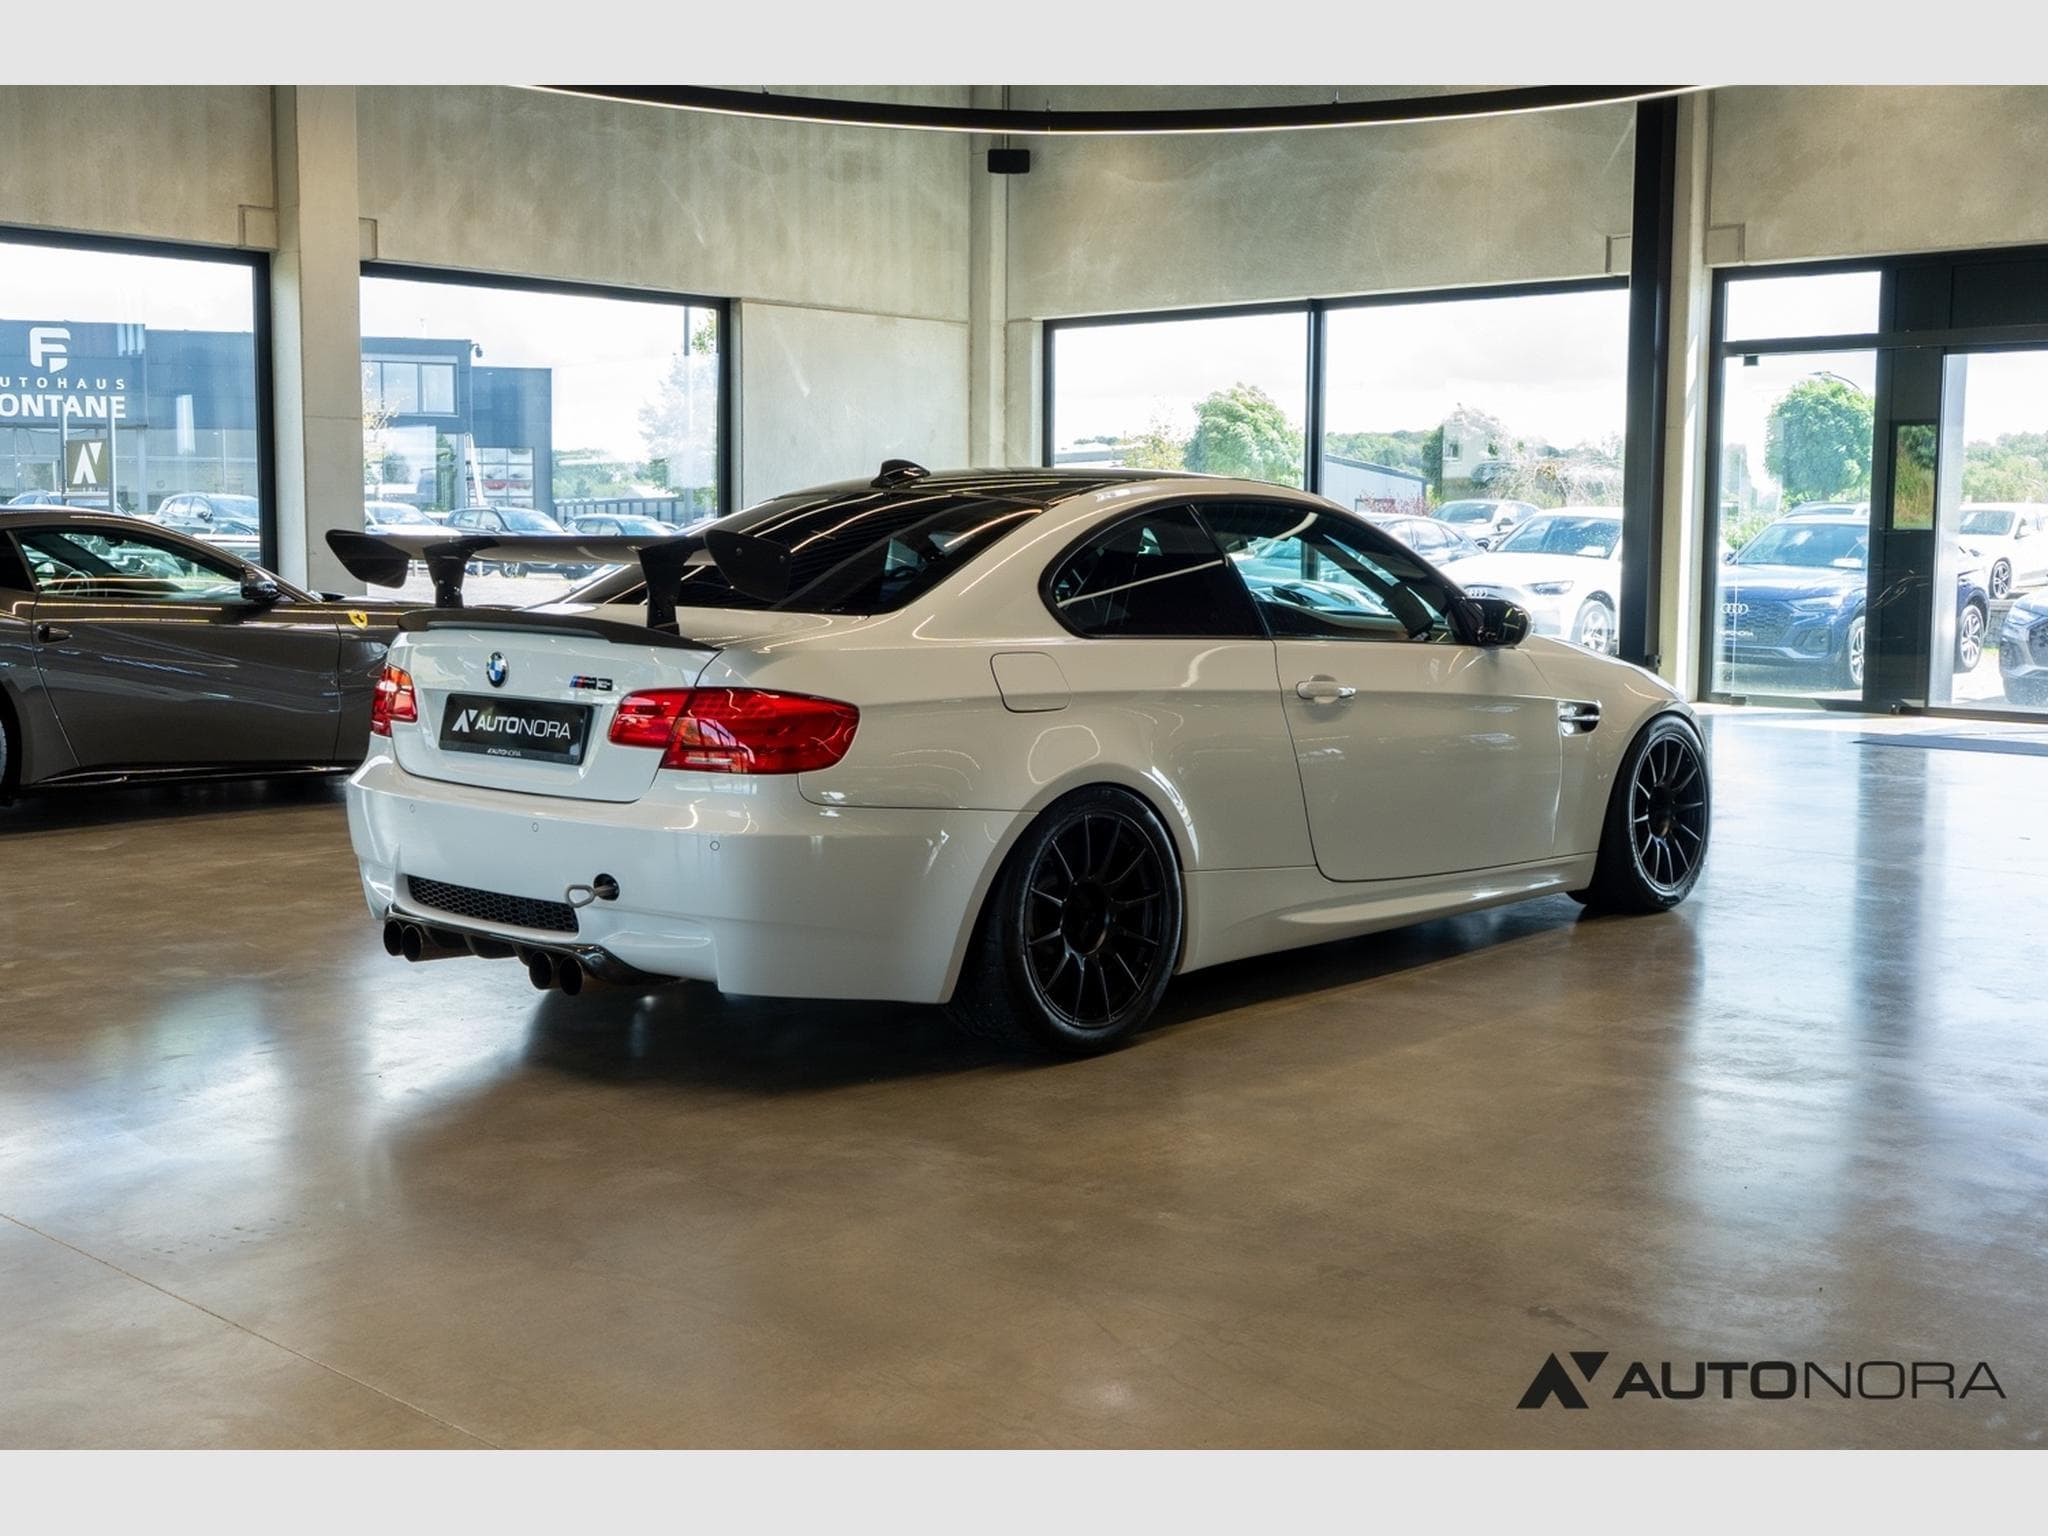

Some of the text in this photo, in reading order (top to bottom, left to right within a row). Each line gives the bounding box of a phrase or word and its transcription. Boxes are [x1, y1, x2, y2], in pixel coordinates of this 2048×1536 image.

[0, 377, 125, 390] UTOHAUS
[0, 393, 126, 418] ONTANE
[475, 713, 572, 740] AUTONORA
